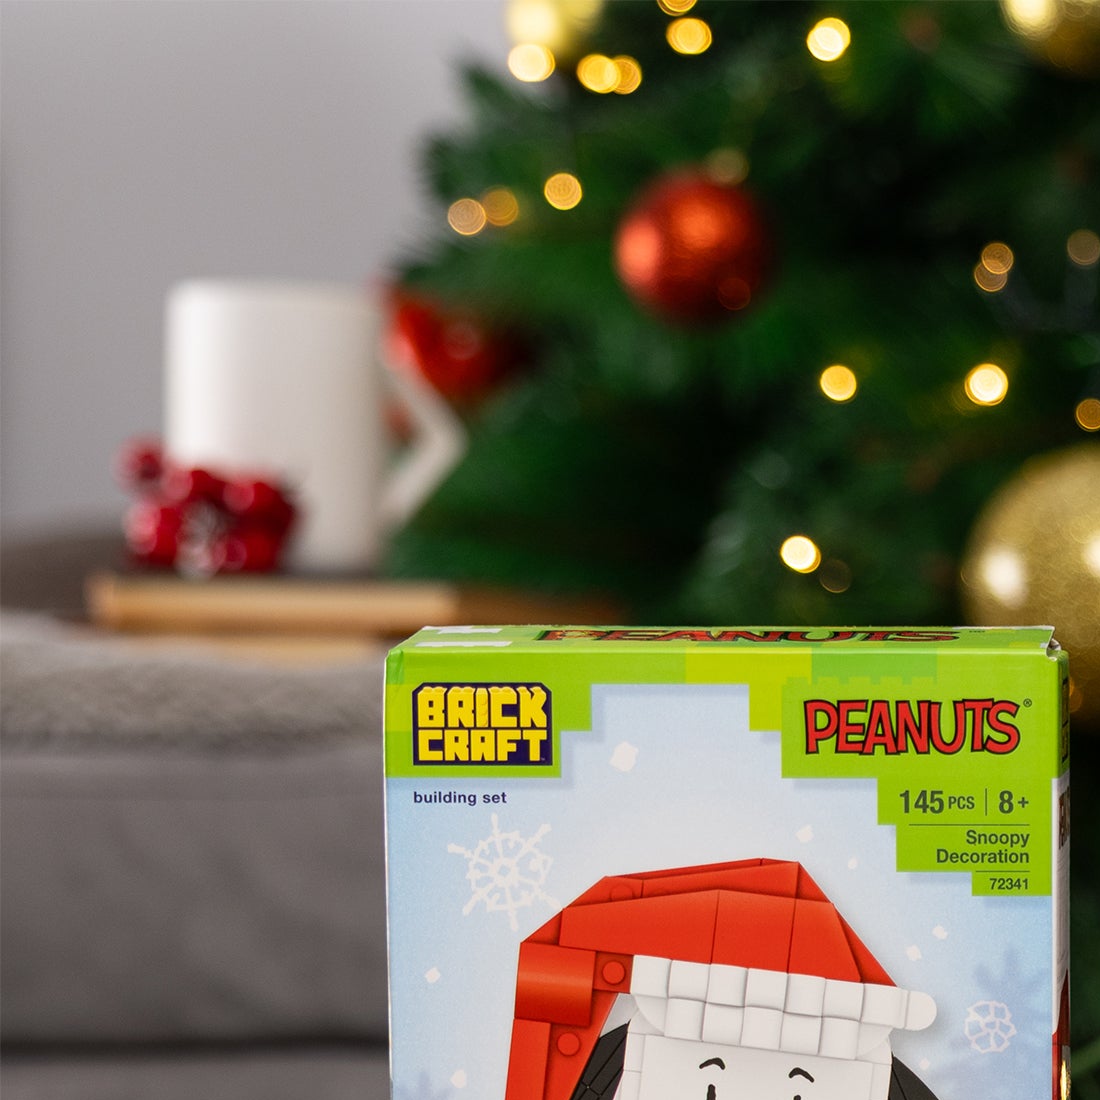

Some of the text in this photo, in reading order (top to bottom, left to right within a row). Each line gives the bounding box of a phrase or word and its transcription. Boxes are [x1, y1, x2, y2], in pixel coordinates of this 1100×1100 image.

[417, 686, 548, 728] BRICK
[417, 729, 548, 762] CRAFT
[413, 790, 508, 807] building set
[899, 789, 1030, 815] 145 PCS 8+
[965, 829, 1030, 848] Snoopy
[936, 848, 1030, 864] Decoration
[989, 877, 1029, 891] 72341
